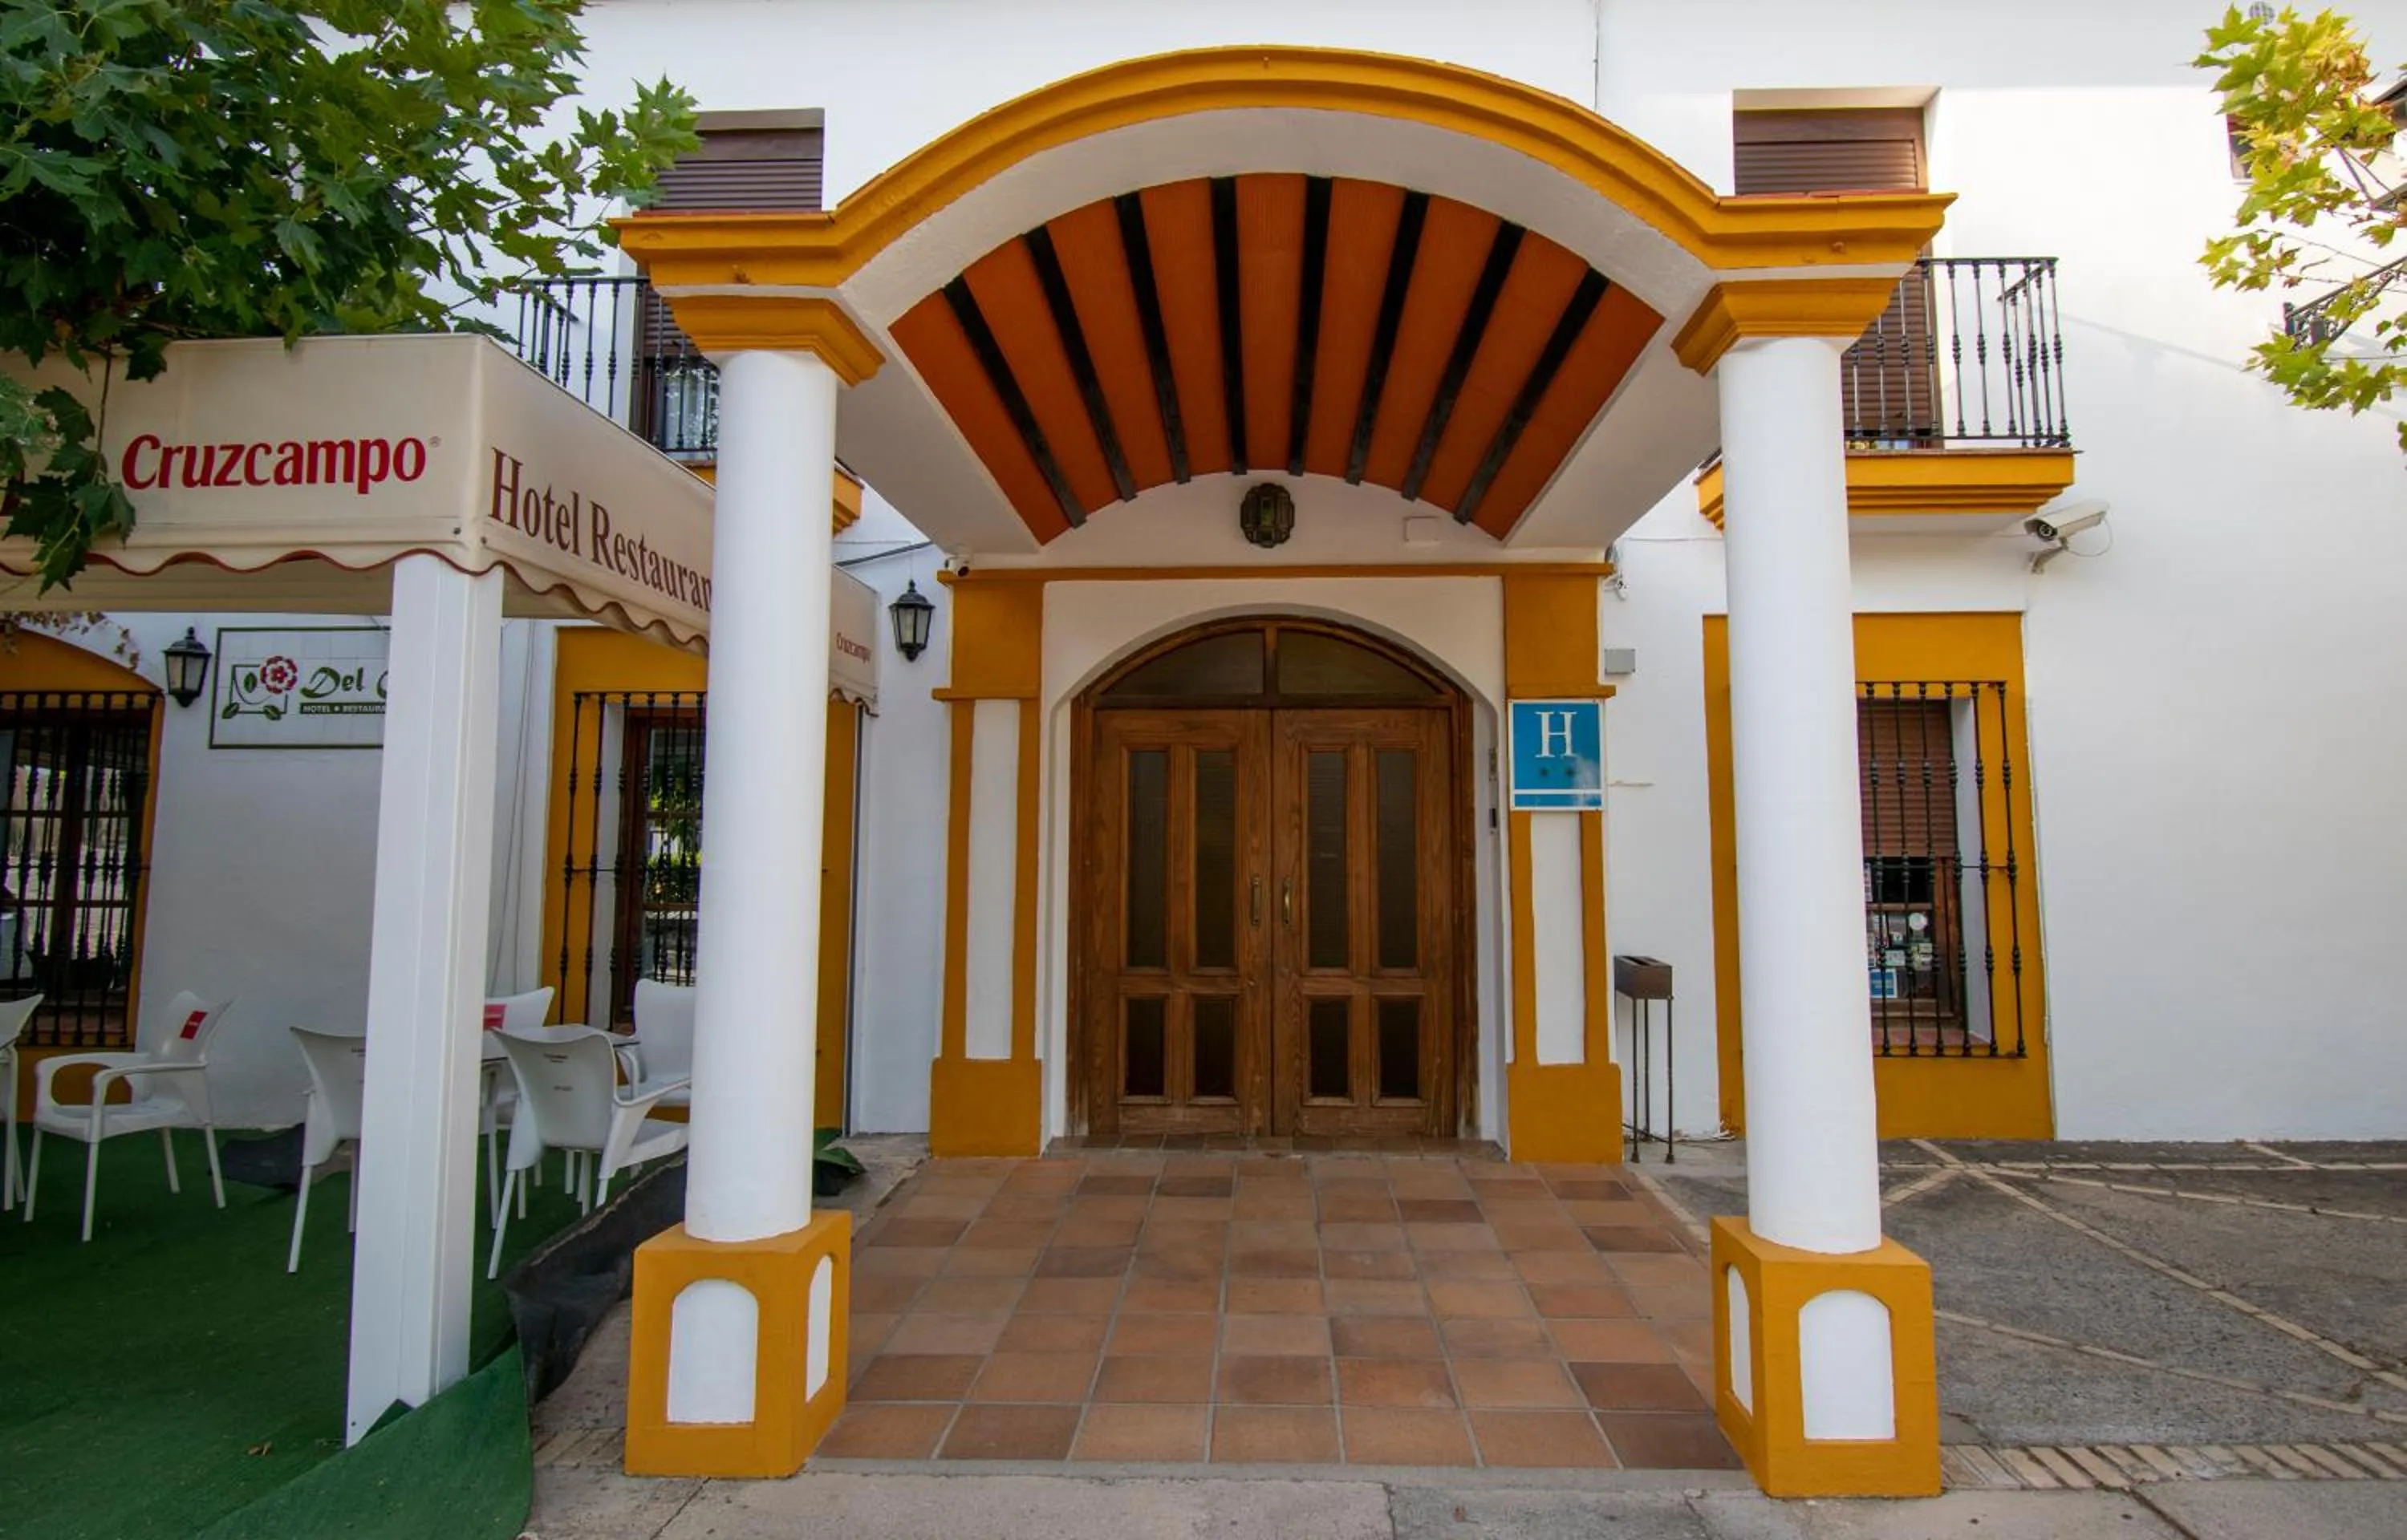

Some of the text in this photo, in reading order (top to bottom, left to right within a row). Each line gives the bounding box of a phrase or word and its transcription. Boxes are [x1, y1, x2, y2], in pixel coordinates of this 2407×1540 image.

[121, 434, 426, 495] Cruzcampo
[488, 447, 581, 557] Hotel
[300, 667, 364, 699] Del
[302, 705, 331, 713] HOTEL
[1534, 711, 1577, 758] H
